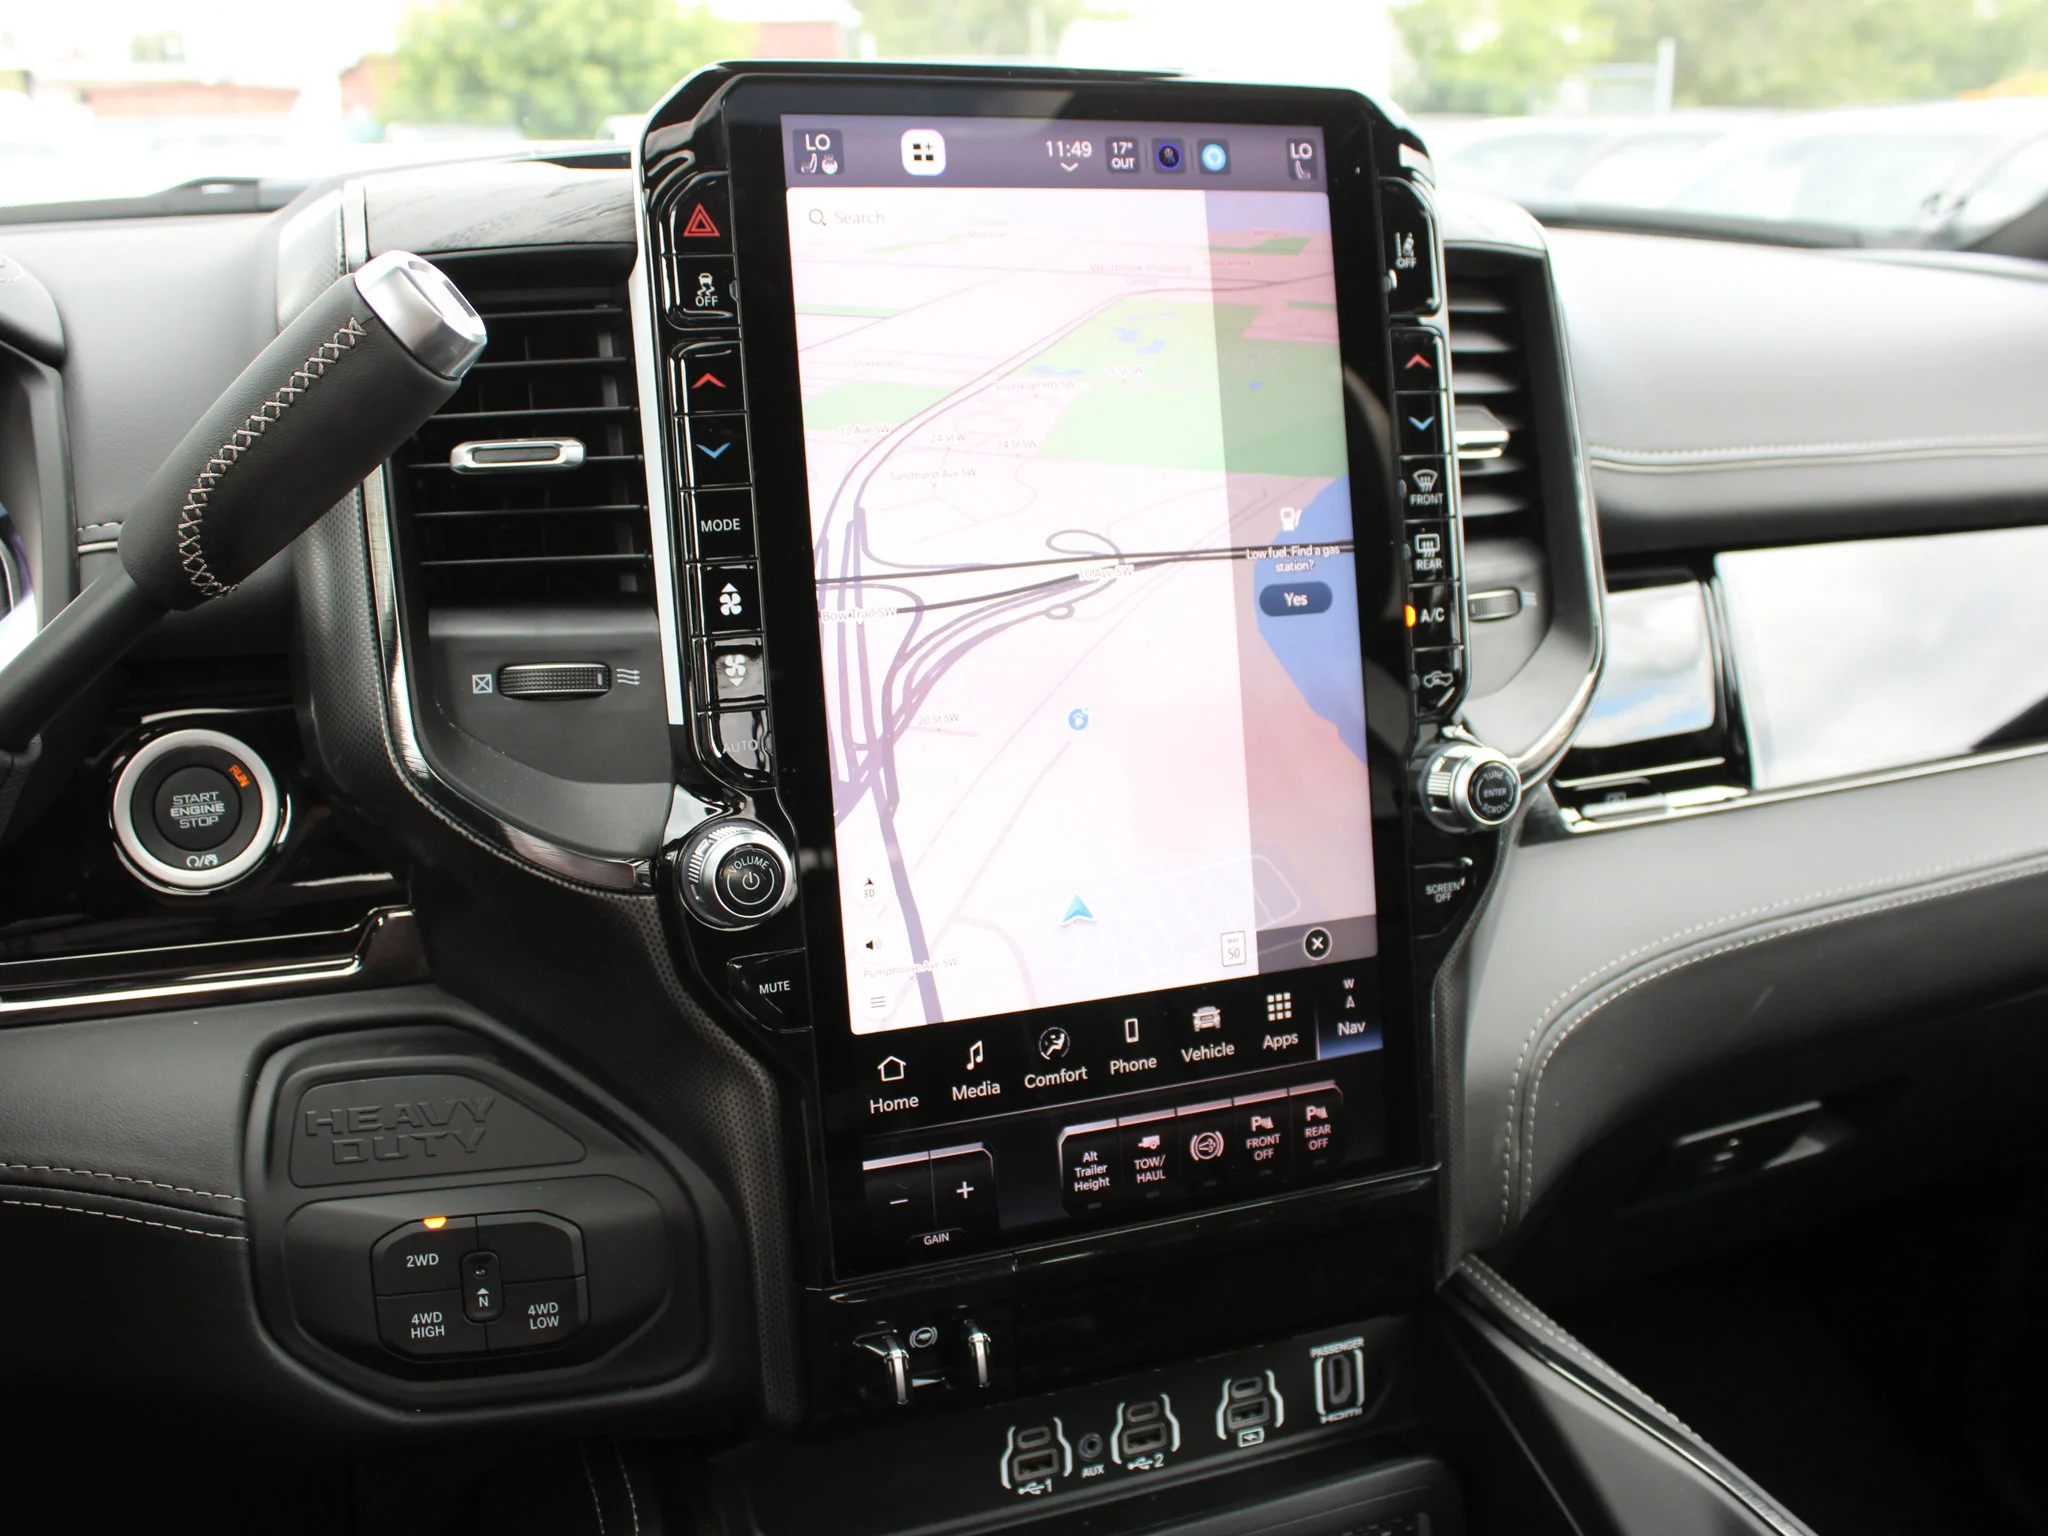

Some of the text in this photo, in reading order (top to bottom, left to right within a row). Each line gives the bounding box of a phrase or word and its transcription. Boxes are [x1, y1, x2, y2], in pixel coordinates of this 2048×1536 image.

[805, 133, 832, 152] LO
[1046, 139, 1092, 158] 11:49
[1290, 142, 1312, 160] LO
[1111, 157, 1135, 170] OUT
[834, 211, 886, 226] Search
[1395, 257, 1416, 270] OFF
[695, 295, 718, 307] OFF
[873, 424, 890, 433] SW
[1410, 493, 1443, 506] FRONT
[701, 518, 741, 533] MODE
[1246, 544, 1341, 560] Low fuel. Find a gas
[1275, 560, 1315, 573] station?
[1416, 558, 1443, 571] REAR
[1285, 592, 1308, 608] Yes
[822, 605, 896, 621] Bow Trail SW
[1420, 608, 1446, 624] A/C
[943, 712, 960, 723] SW
[722, 741, 759, 754] AUTO
[229, 764, 250, 788] RUN
[1483, 771, 1504, 781] TUNE
[172, 791, 220, 805] START
[1483, 787, 1508, 799] ENTER
[170, 802, 226, 817] ENGINE
[1481, 801, 1509, 814] SCROLL
[179, 815, 220, 829] STOP
[728, 857, 770, 875] VOLUME
[1425, 880, 1460, 896] SCREEN
[1435, 892, 1453, 904] OFF
[1227, 947, 1241, 960] 50
[863, 964, 921, 979] Pumphouse
[758, 980, 791, 996] MUTE
[1343, 978, 1355, 989] W
[1337, 1020, 1367, 1036] Nav
[1262, 1030, 1299, 1050] Apps
[1181, 1040, 1236, 1060] Vehicle
[1109, 1056, 1158, 1076] Phone
[1024, 1065, 1088, 1090] Comfort
[951, 1081, 1001, 1101] Media
[869, 1095, 919, 1114] Home
[305, 1096, 496, 1137] HEAVY
[1304, 1124, 1332, 1140] REAR
[332, 1128, 487, 1165] DUTY
[1246, 1133, 1281, 1150] FRONT
[1309, 1137, 1328, 1152] OFF
[1083, 1151, 1099, 1164] Alt
[1134, 1154, 1166, 1170] TOW/
[1254, 1148, 1274, 1162] OFF
[1074, 1163, 1108, 1179] Trailer
[1136, 1169, 1166, 1184] HAUL
[1074, 1177, 1110, 1193] Height
[924, 1232, 950, 1246] GAIN
[406, 1252, 439, 1268] 2WD
[478, 1296, 489, 1307] N
[528, 1302, 559, 1317] 4WD
[411, 1311, 443, 1326] 4WD
[530, 1315, 560, 1331] LOW
[411, 1325, 445, 1340] HIGH
[1310, 1336, 1365, 1358] PASSENGER
[1154, 1452, 1165, 1469] 2
[1081, 1464, 1105, 1479] AUX
[1044, 1478, 1052, 1493] 1
